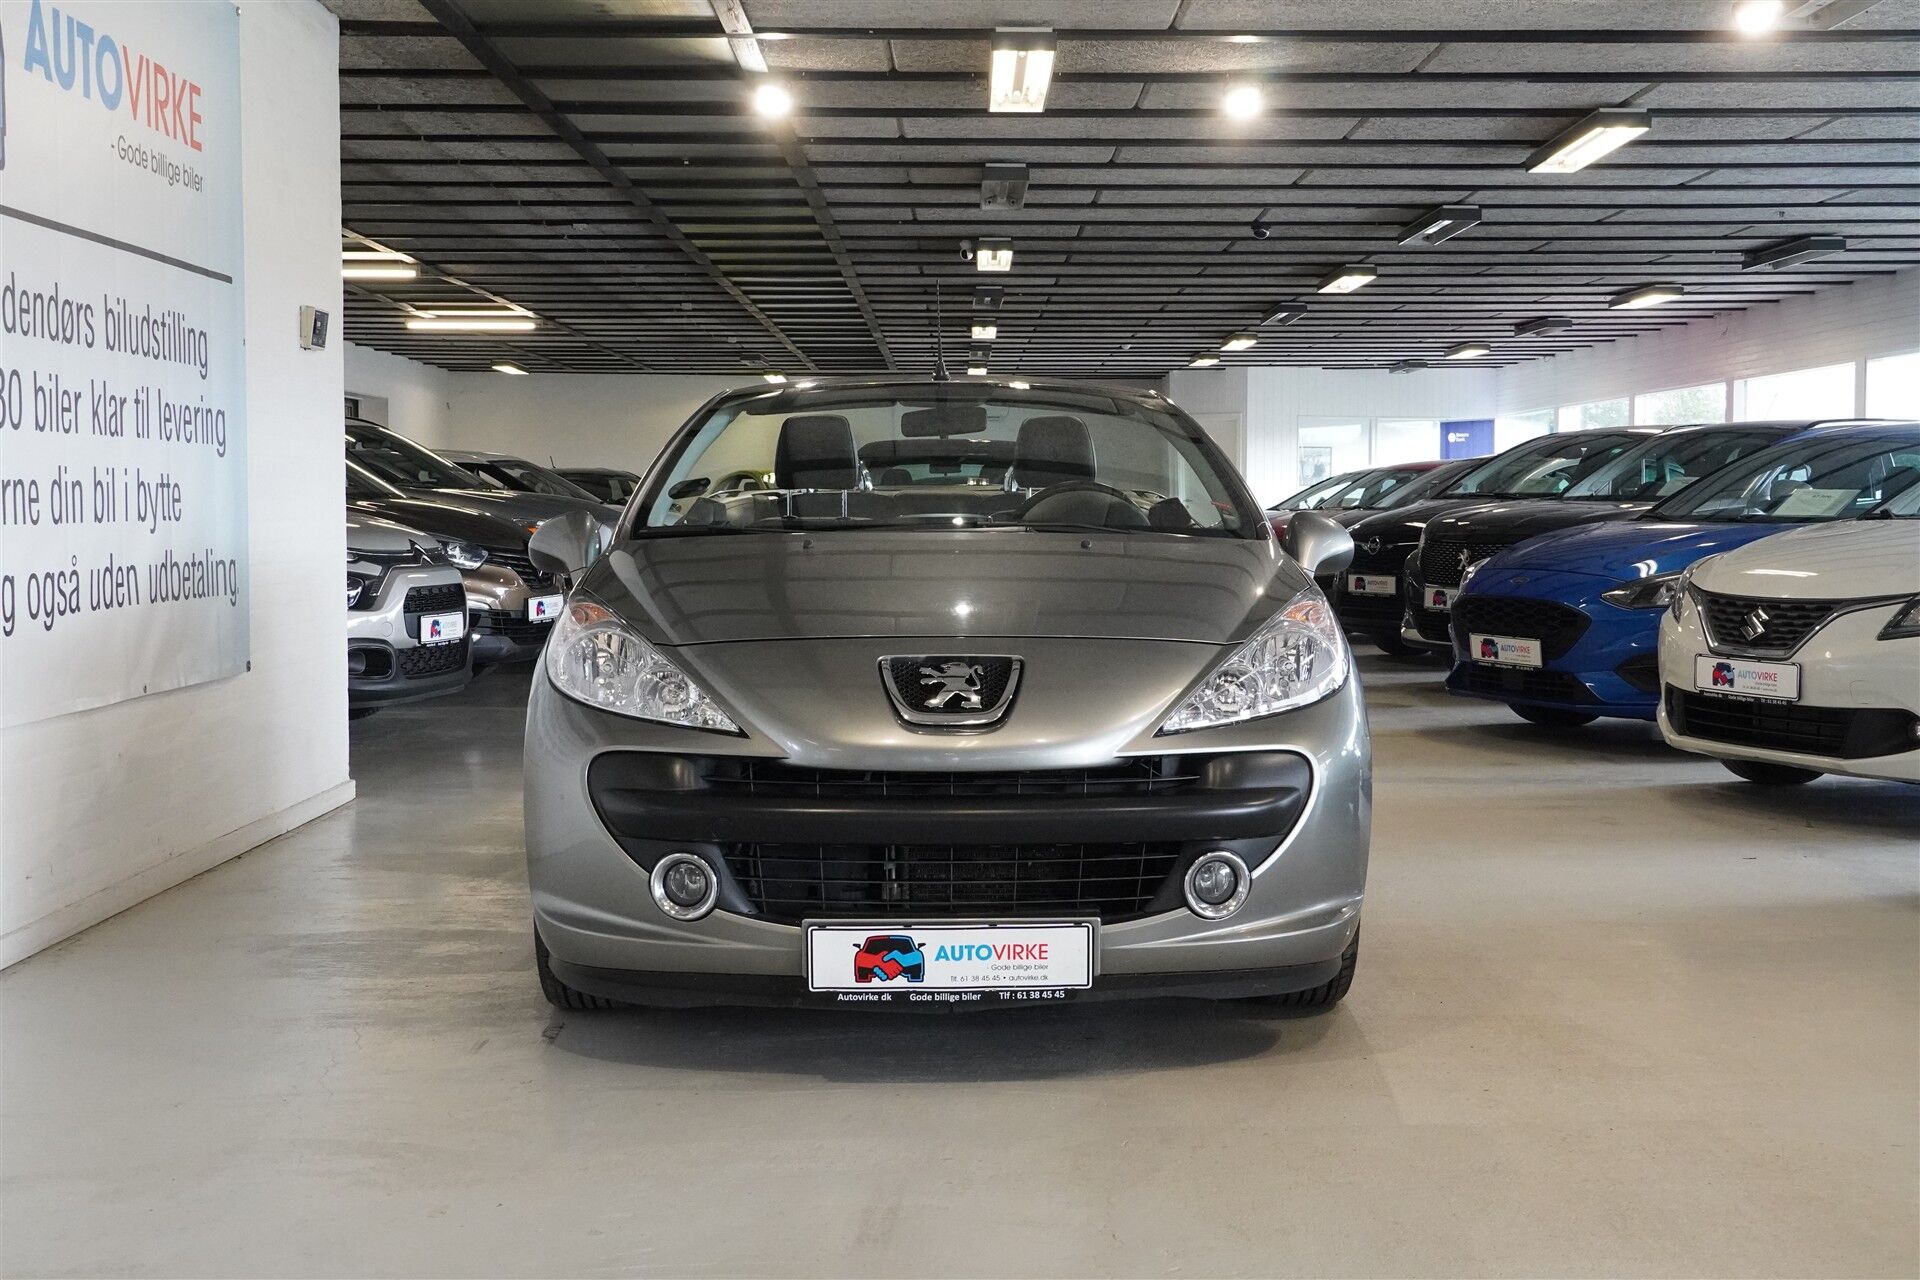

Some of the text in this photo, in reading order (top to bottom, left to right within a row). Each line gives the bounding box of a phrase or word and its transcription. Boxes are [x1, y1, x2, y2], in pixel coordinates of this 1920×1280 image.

[24, 0, 203, 152] AUTOVIRKE
[117, 135, 148, 169] Gode
[151, 149, 181, 187] billige
[183, 169, 203, 192] biler
[104, 293, 208, 380] biludstilling
[33, 370, 82, 434] biler
[91, 379, 127, 437] klar
[134, 386, 150, 439] til
[158, 388, 226, 458] levering
[1, 465, 182, 534] rne din bil i bytte
[27, 555, 81, 631] også
[90, 553, 140, 611] uden
[1738, 670, 1778, 682] AUTOVIRKE
[935, 944, 1049, 961] AUTOVIRKE
[1013, 963, 1033, 971] billige
[837, 993, 892, 1001] Autovirke dk
[909, 993, 982, 1002] Gode billige biler
[999, 992, 1010, 1000] Tlf
[1017, 992, 1027, 1000] 61
[1030, 991, 1041, 999] 38
[1042, 991, 1053, 999] 45
[1055, 990, 1065, 998] 45
